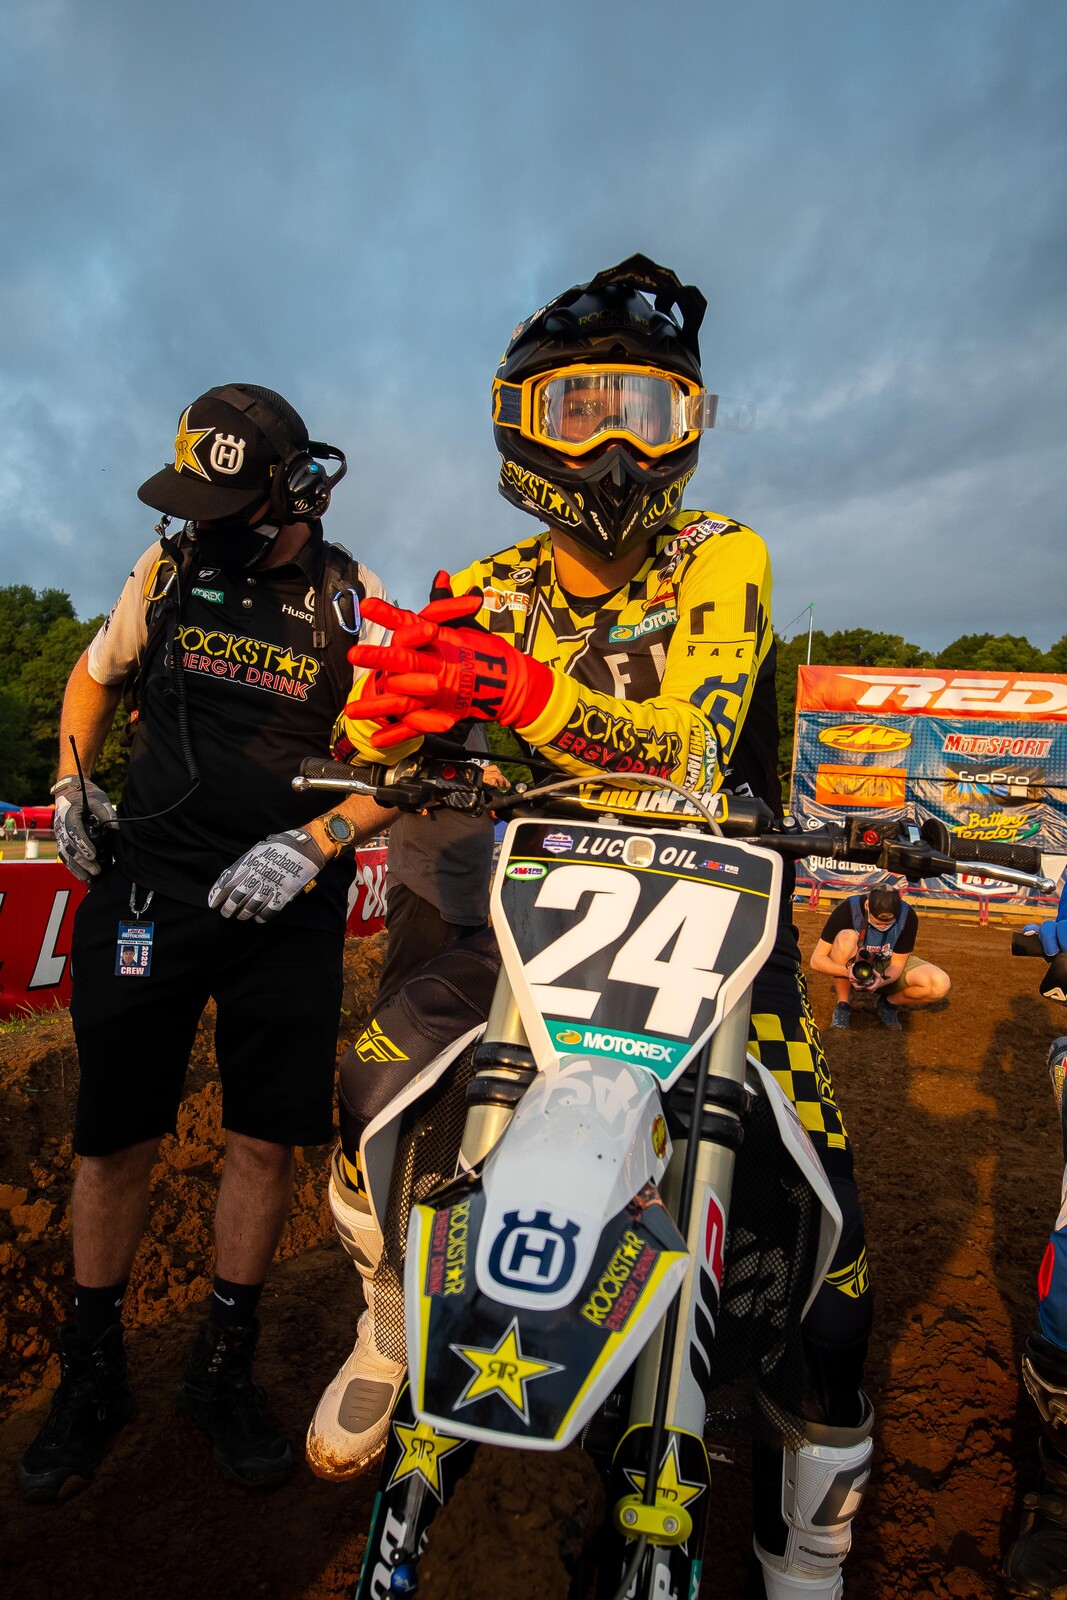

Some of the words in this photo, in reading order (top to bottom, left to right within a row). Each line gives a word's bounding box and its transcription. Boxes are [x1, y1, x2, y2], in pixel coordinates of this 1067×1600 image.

[590, 511, 608, 540] Airoh
[245, 666, 310, 699] DRINK
[471, 650, 507, 718] FLY
[820, 727, 911, 746] FMF
[958, 770, 1030, 785] GoPro
[968, 812, 1029, 830] Battery
[952, 826, 1018, 842] Tender
[575, 836, 624, 858] LUC
[141, 945, 149, 966] 2020
[523, 864, 741, 1038] 24
[120, 966, 144, 975] CREW
[583, 1031, 673, 1063] MOTOREX
[444, 1200, 471, 1296] ROCKSTAR
[582, 1230, 645, 1326] ROCKSTAR
